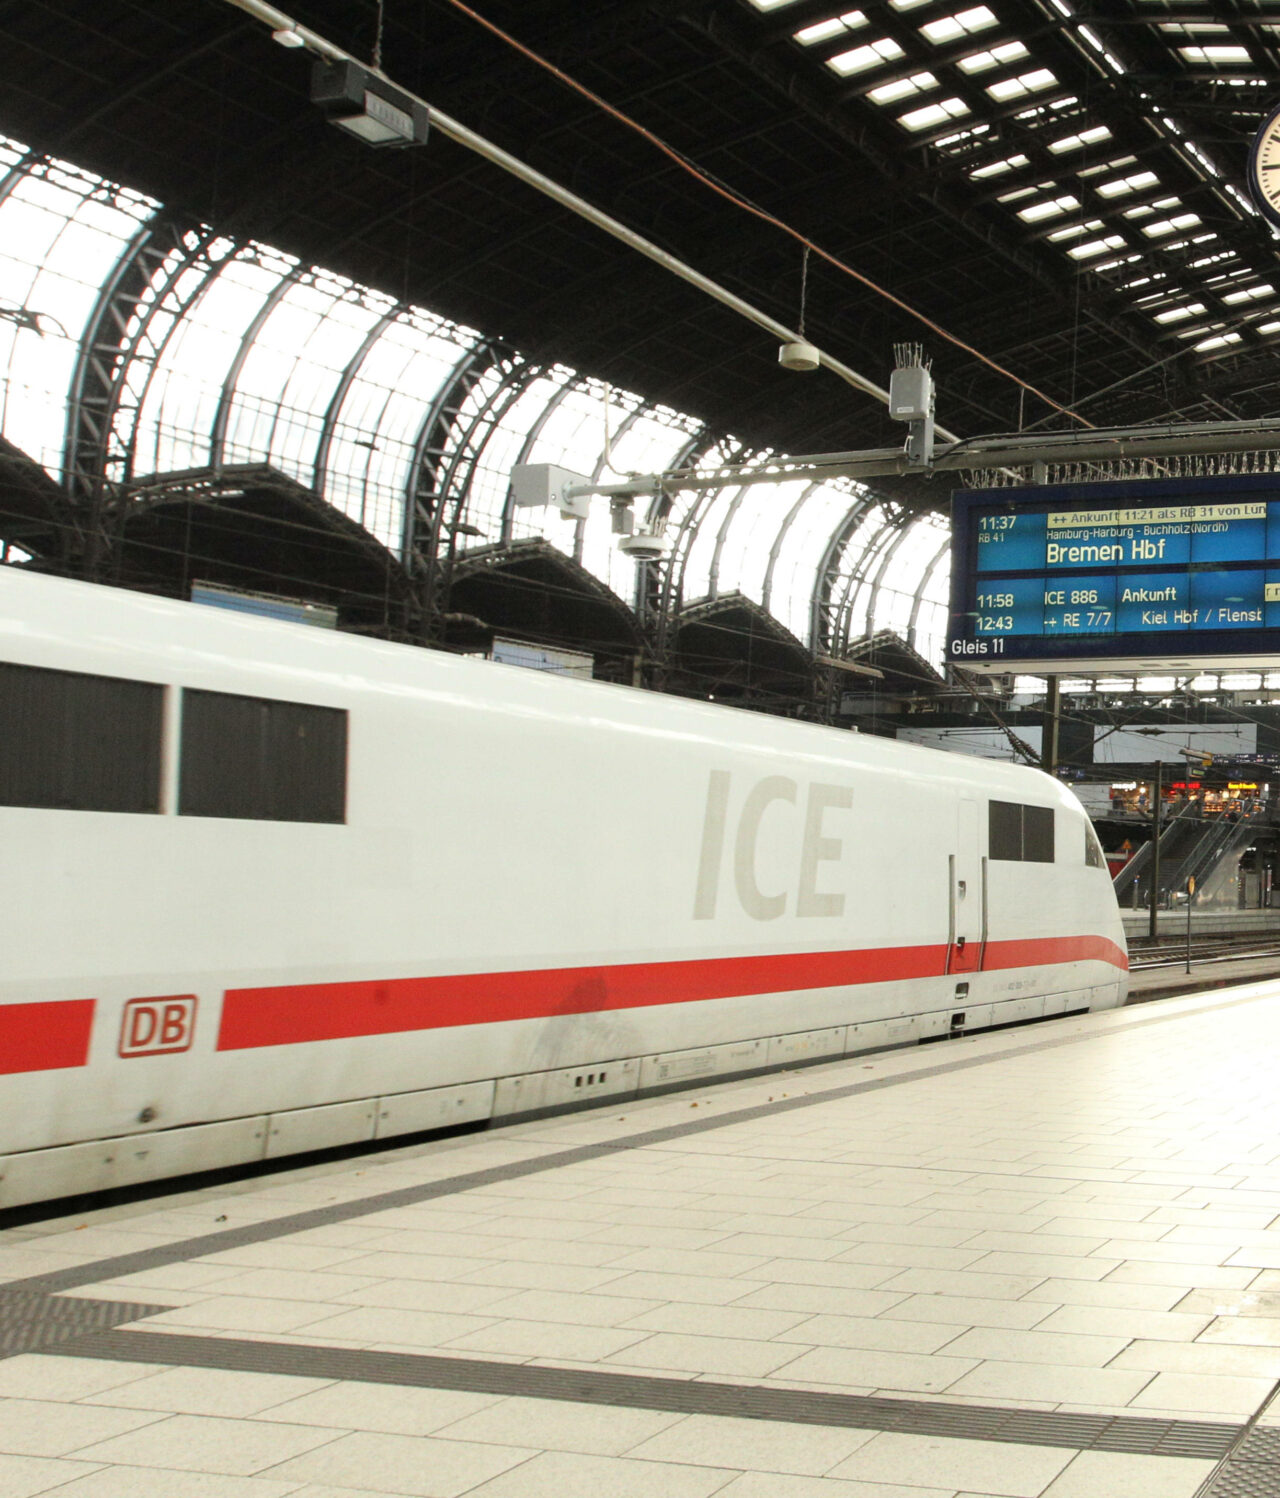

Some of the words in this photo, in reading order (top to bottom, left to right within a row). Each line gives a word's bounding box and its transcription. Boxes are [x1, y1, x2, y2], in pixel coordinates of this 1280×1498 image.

[980, 515, 1017, 530] 11:37
[1071, 510, 1120, 523] Ankunft
[1125, 509, 1153, 521] 11:21
[1157, 508, 1176, 520] als
[1180, 507, 1196, 518] RB
[1200, 507, 1213, 517] 31
[1219, 507, 1241, 517] von
[978, 533, 990, 543] RB
[993, 532, 1005, 542] 41
[1046, 527, 1134, 541] Hamburg-Harburg
[1047, 543, 1123, 563] Bremen
[1131, 539, 1166, 560] Hbf
[976, 594, 1014, 608] 11:58
[1044, 592, 1065, 605] ICE
[1070, 590, 1098, 603] 886
[1121, 587, 1177, 602] Ankunft
[976, 616, 1013, 630] 12:43
[1063, 613, 1080, 627] RE
[1086, 611, 1112, 626] 7/7
[1142, 610, 1167, 625] Kiel
[1174, 609, 1198, 623] Hbf
[1205, 608, 1213, 623] /
[951, 639, 988, 655] Gleis
[992, 638, 1004, 653] 11
[692, 769, 854, 922] ICE
[129, 1004, 187, 1048] DB
